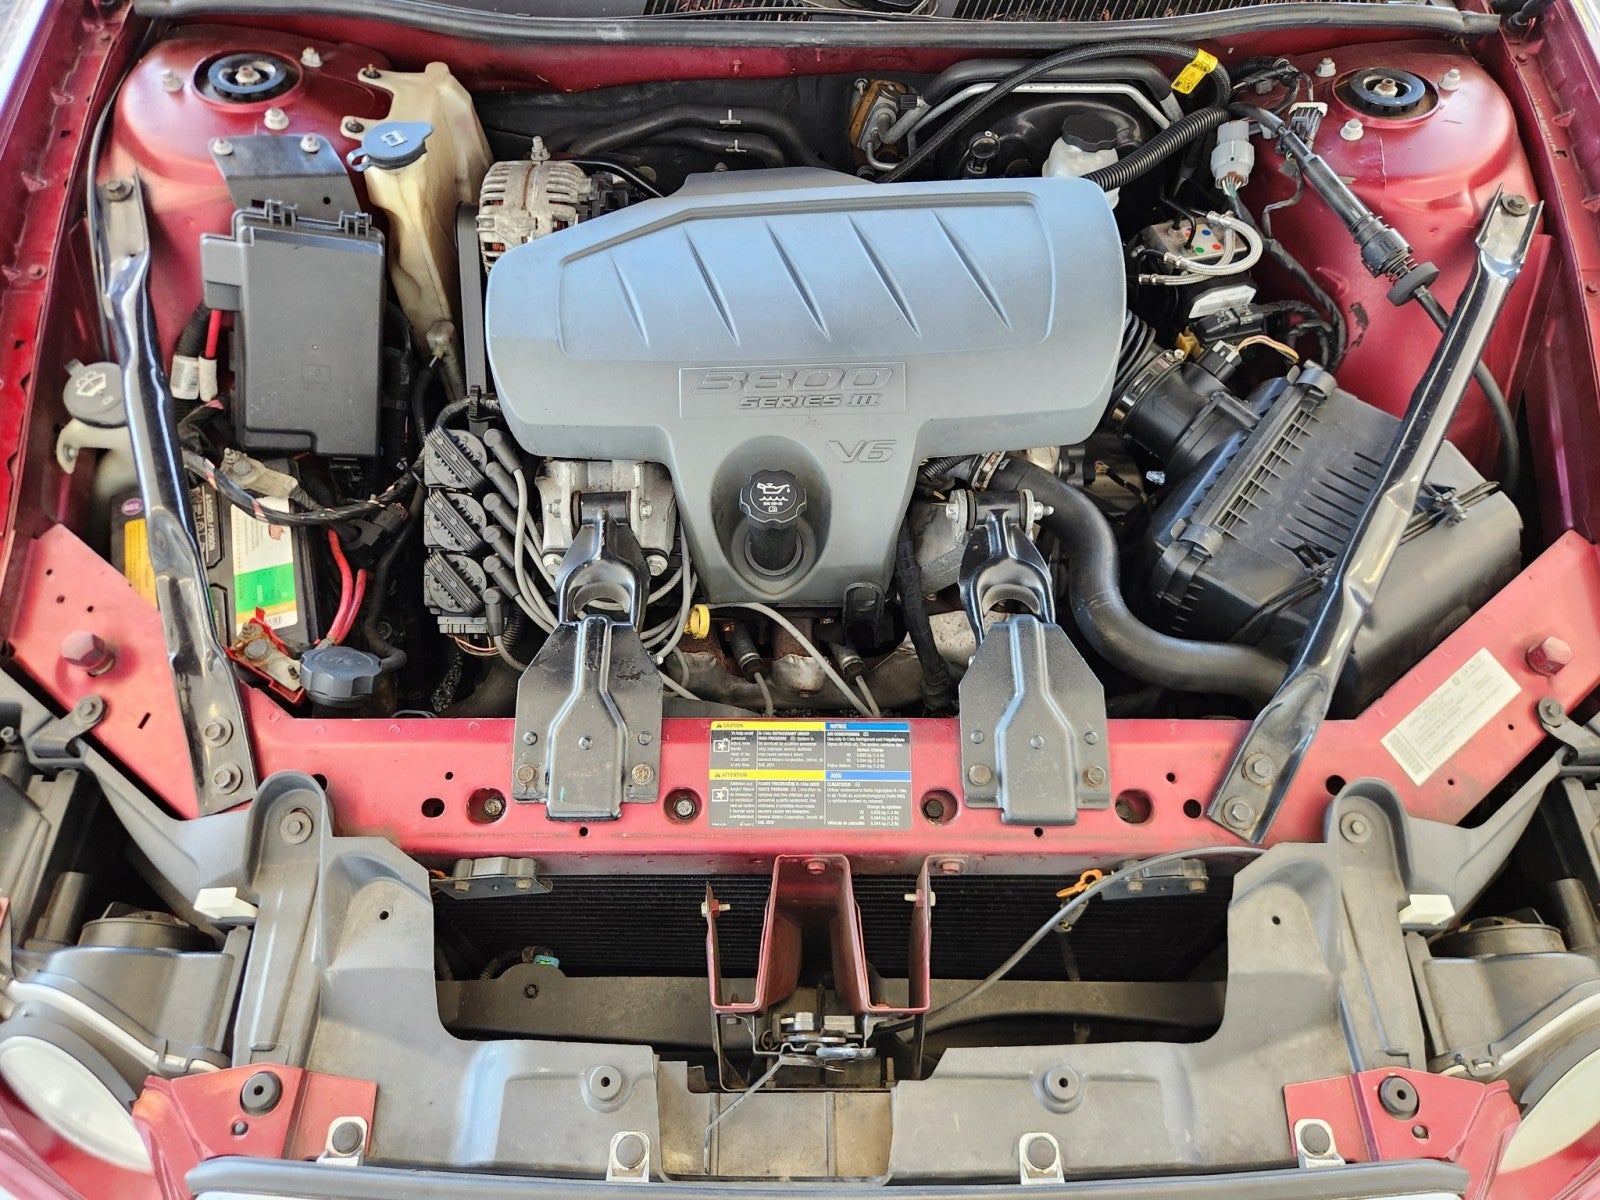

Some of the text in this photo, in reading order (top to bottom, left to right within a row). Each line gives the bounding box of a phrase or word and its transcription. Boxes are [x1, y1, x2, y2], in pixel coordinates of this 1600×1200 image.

[693, 368, 893, 394] 3800
[738, 394, 842, 409] SERIES
[828, 440, 896, 463] V6
